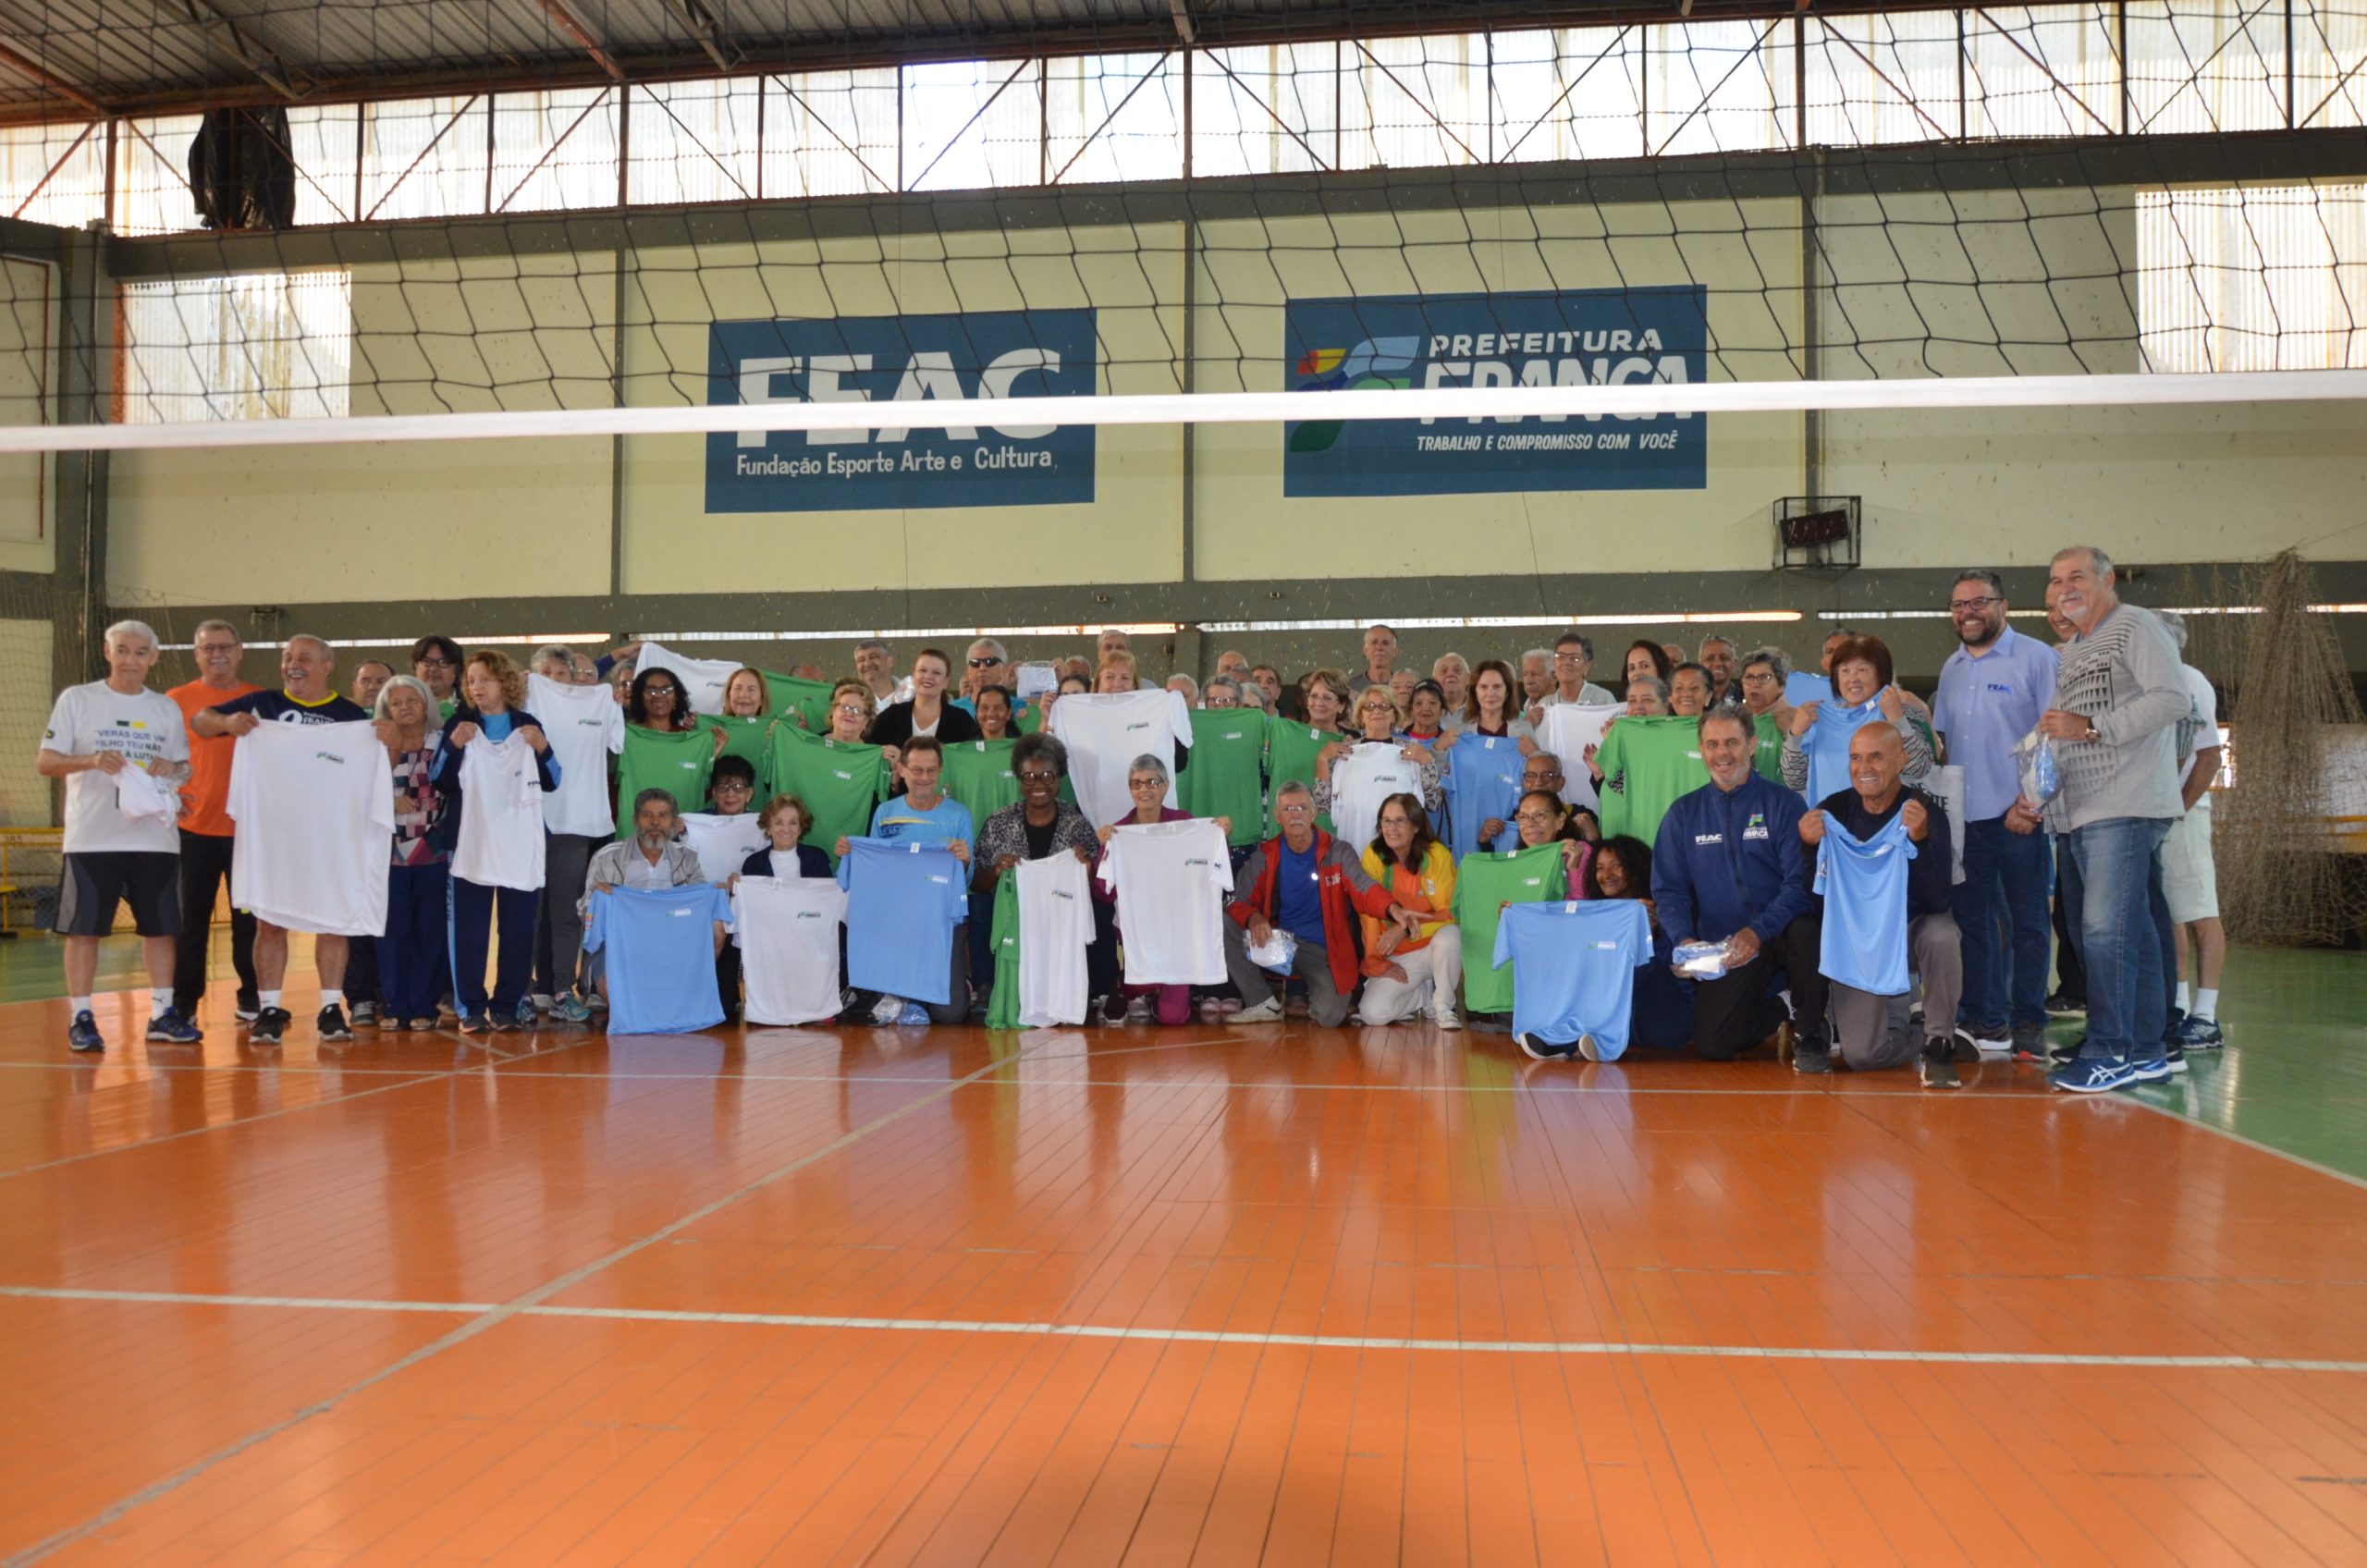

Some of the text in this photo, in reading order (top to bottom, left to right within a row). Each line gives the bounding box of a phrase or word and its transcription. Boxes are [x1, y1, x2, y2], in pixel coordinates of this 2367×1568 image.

[1429, 328, 1663, 357] PREFEITURA
[736, 348, 1061, 447] FEAC
[1420, 355, 1692, 425] FRANCA
[1417, 429, 1678, 451] TRABALHO E COMPROMISSO COM VOCÊ
[737, 445, 1052, 479] Fundação Esporte Arte e Cultura
[95, 740, 124, 748] FILHO
[128, 741, 144, 749] TEU
[133, 731, 152, 740] QUE
[1695, 833, 1723, 843] FEAC
